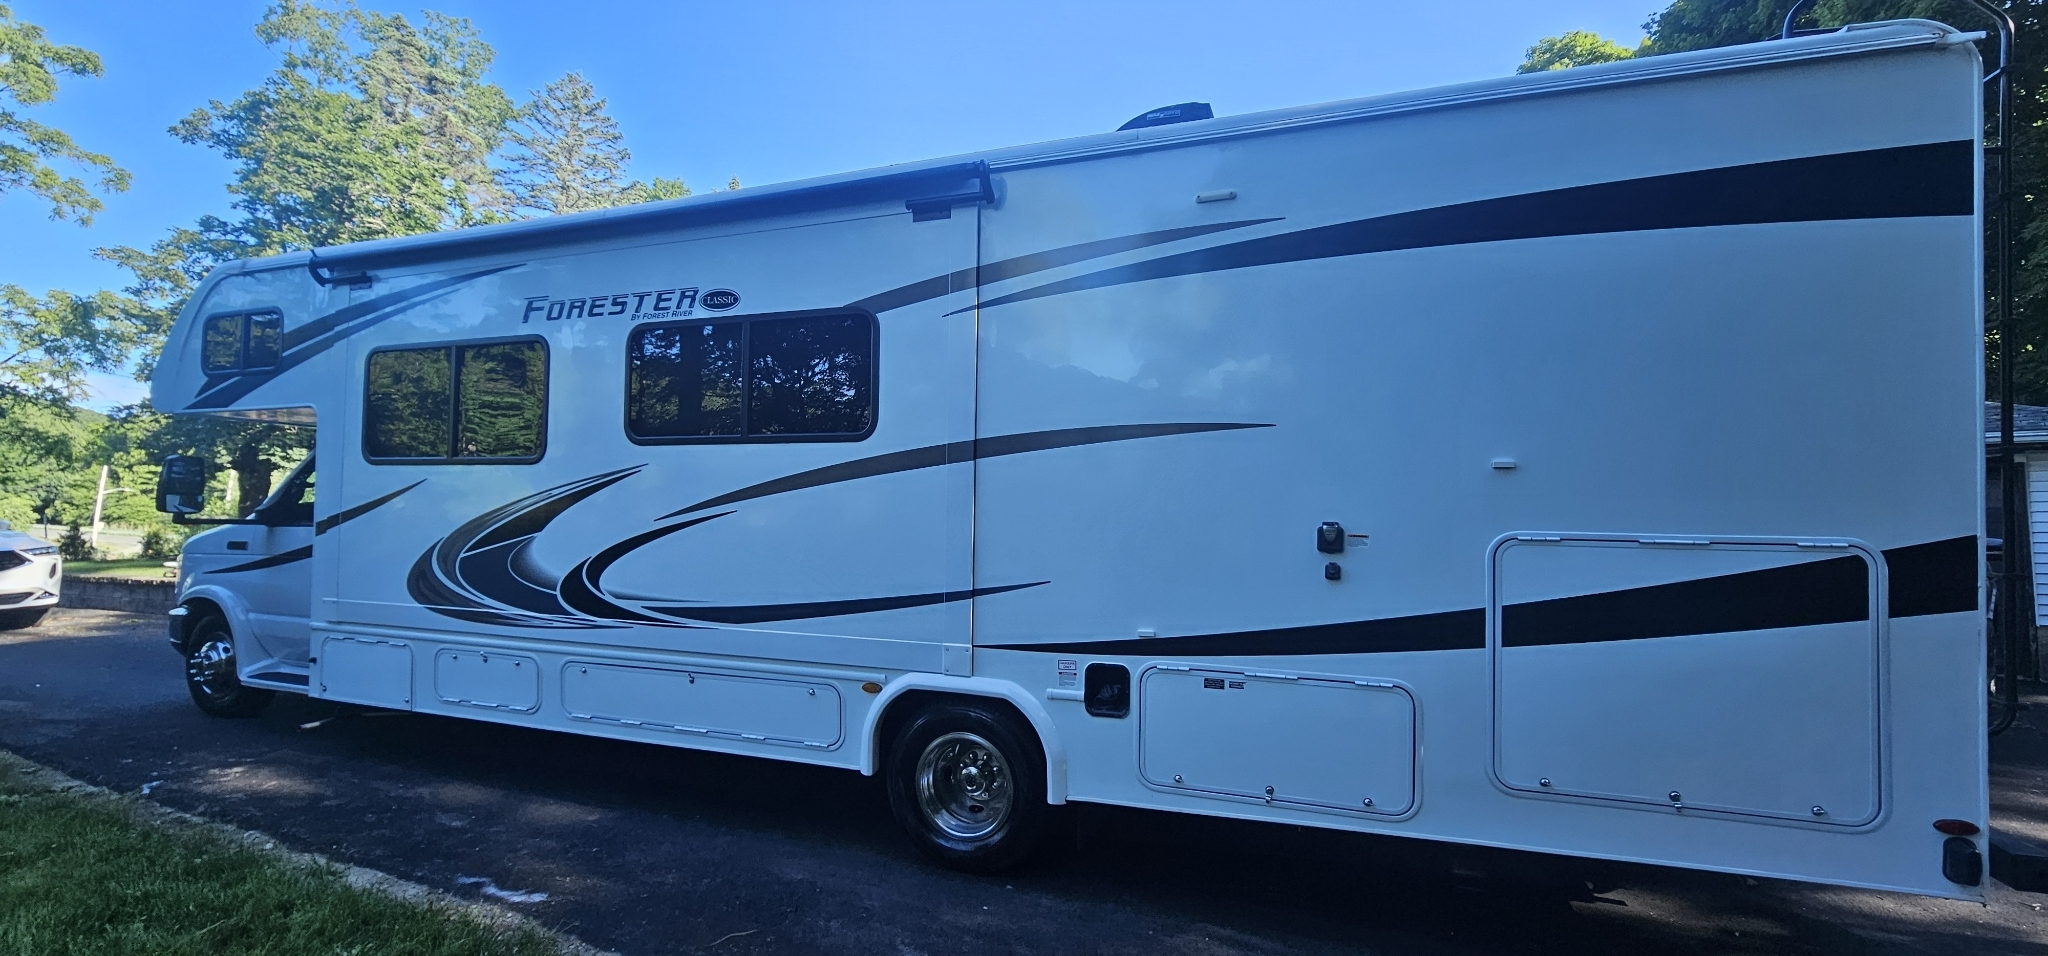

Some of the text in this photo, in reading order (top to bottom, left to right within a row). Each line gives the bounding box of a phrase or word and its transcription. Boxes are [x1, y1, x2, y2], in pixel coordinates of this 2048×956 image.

[522, 287, 699, 323] FORESTER
[701, 295, 738, 304] CLASSIC
[631, 310, 693, 321] BY FOREST RIVER
